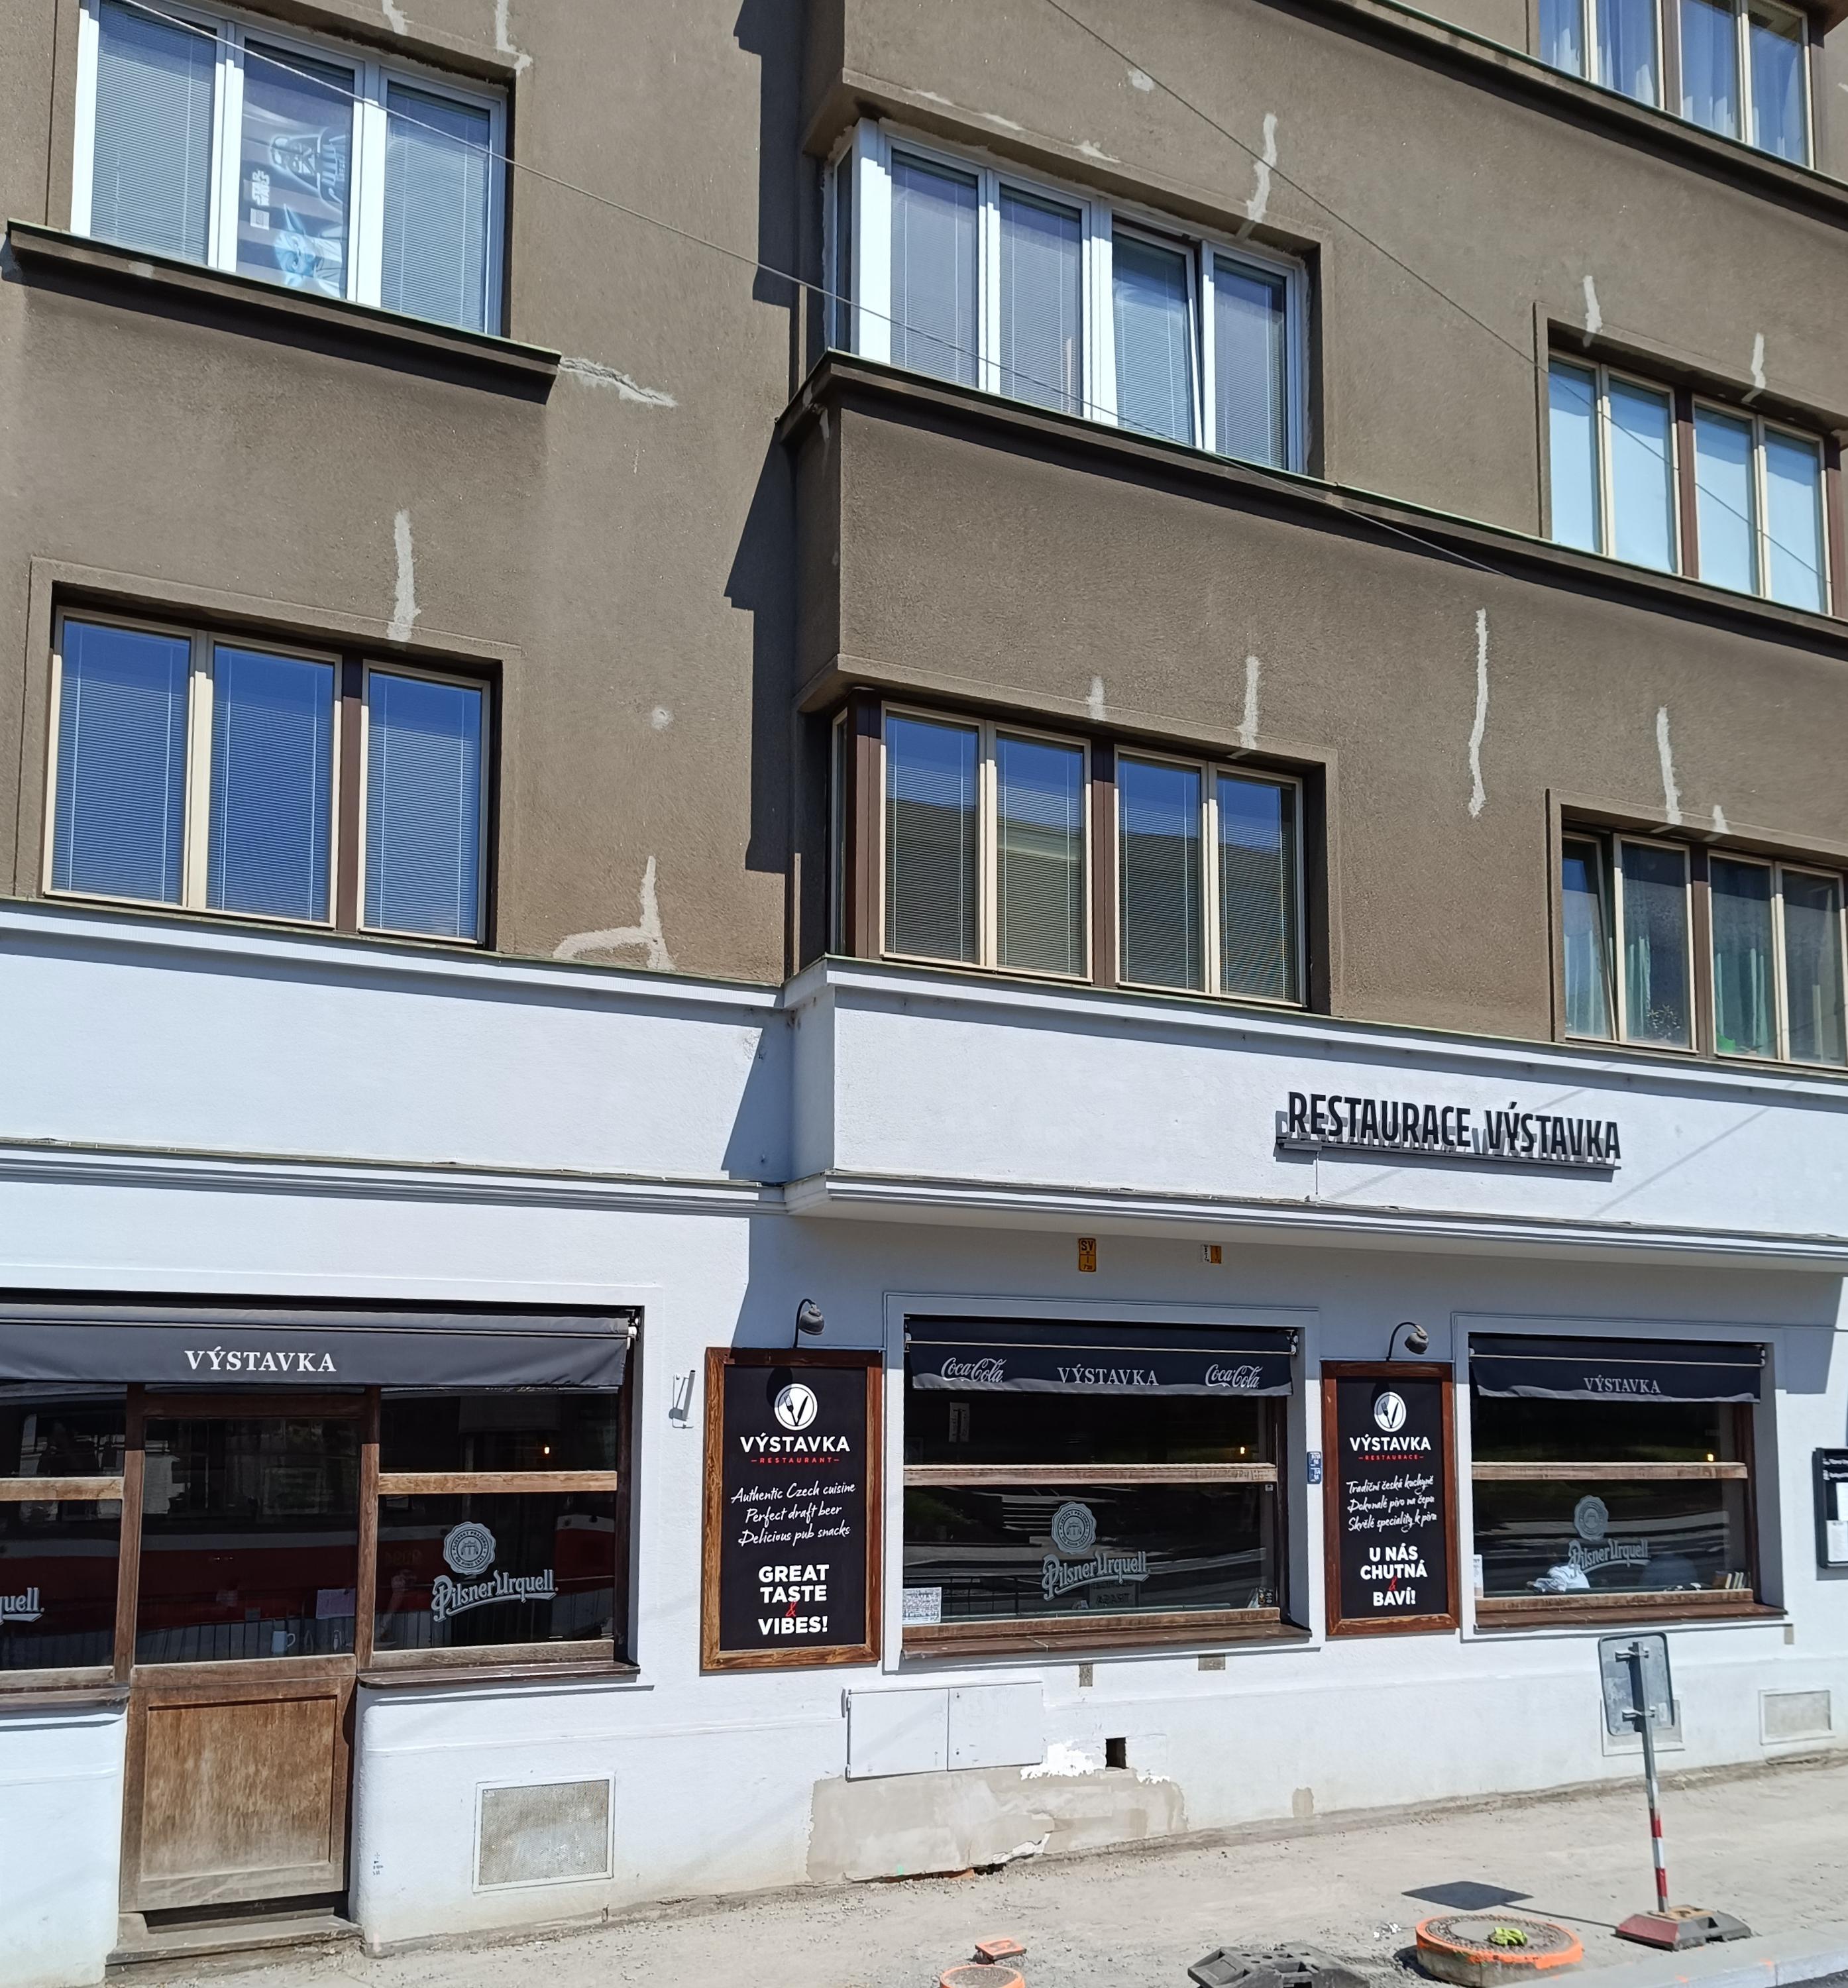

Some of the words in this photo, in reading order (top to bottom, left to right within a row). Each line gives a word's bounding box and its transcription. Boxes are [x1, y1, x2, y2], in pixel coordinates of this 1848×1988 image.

[1288, 1091, 1471, 1147] RESTAURACE
[1484, 1101, 1621, 1159] VÝSTAVKA
[184, 1346, 337, 1372] VÝSTAVKA
[941, 1357, 1006, 1382] Coca-Cola
[1057, 1364, 1159, 1386] VÝSTAVKA
[1205, 1364, 1262, 1388] Coca-Cola
[1584, 1374, 1661, 1394] VÝSTAVKA
[739, 1432, 850, 1453] VÝSTAVKA
[1349, 1433, 1431, 1451] VÝSTAVKA
[731, 1486, 783, 1504] Authentic
[787, 1480, 820, 1498] Czech
[823, 1482, 856, 1495] cuisine
[1346, 1479, 1381, 1494] Tradiční
[1382, 1475, 1403, 1491] česká
[1404, 1473, 1434, 1495] kuchyně
[745, 1506, 787, 1527] Perfect
[788, 1502, 818, 1523] draft
[818, 1500, 842, 1516] beer
[1347, 1495, 1388, 1513] Dokonalé
[1387, 1497, 1405, 1513] pivo
[1348, 1514, 1375, 1531] Skvělé
[1377, 1511, 1415, 1533] speciality
[1414, 1509, 1421, 1524] k
[738, 1528, 792, 1547] Delicious
[792, 1523, 814, 1547] pub
[817, 1519, 851, 1537] snacks
[1369, 1547, 1381, 1562] U
[1385, 1543, 1418, 1561] NÁS
[1568, 1539, 1610, 1578] Pilsner
[758, 1564, 830, 1582] GREAT
[1042, 1554, 1097, 1601] Pilsner
[1360, 1559, 1428, 1580] CHUTNÁ
[431, 1575, 496, 1623] Pilsner
[759, 1584, 827, 1603] TASTE
[1373, 1586, 1416, 1606] BAVÍ!
[757, 1616, 828, 1635] VIBES!
